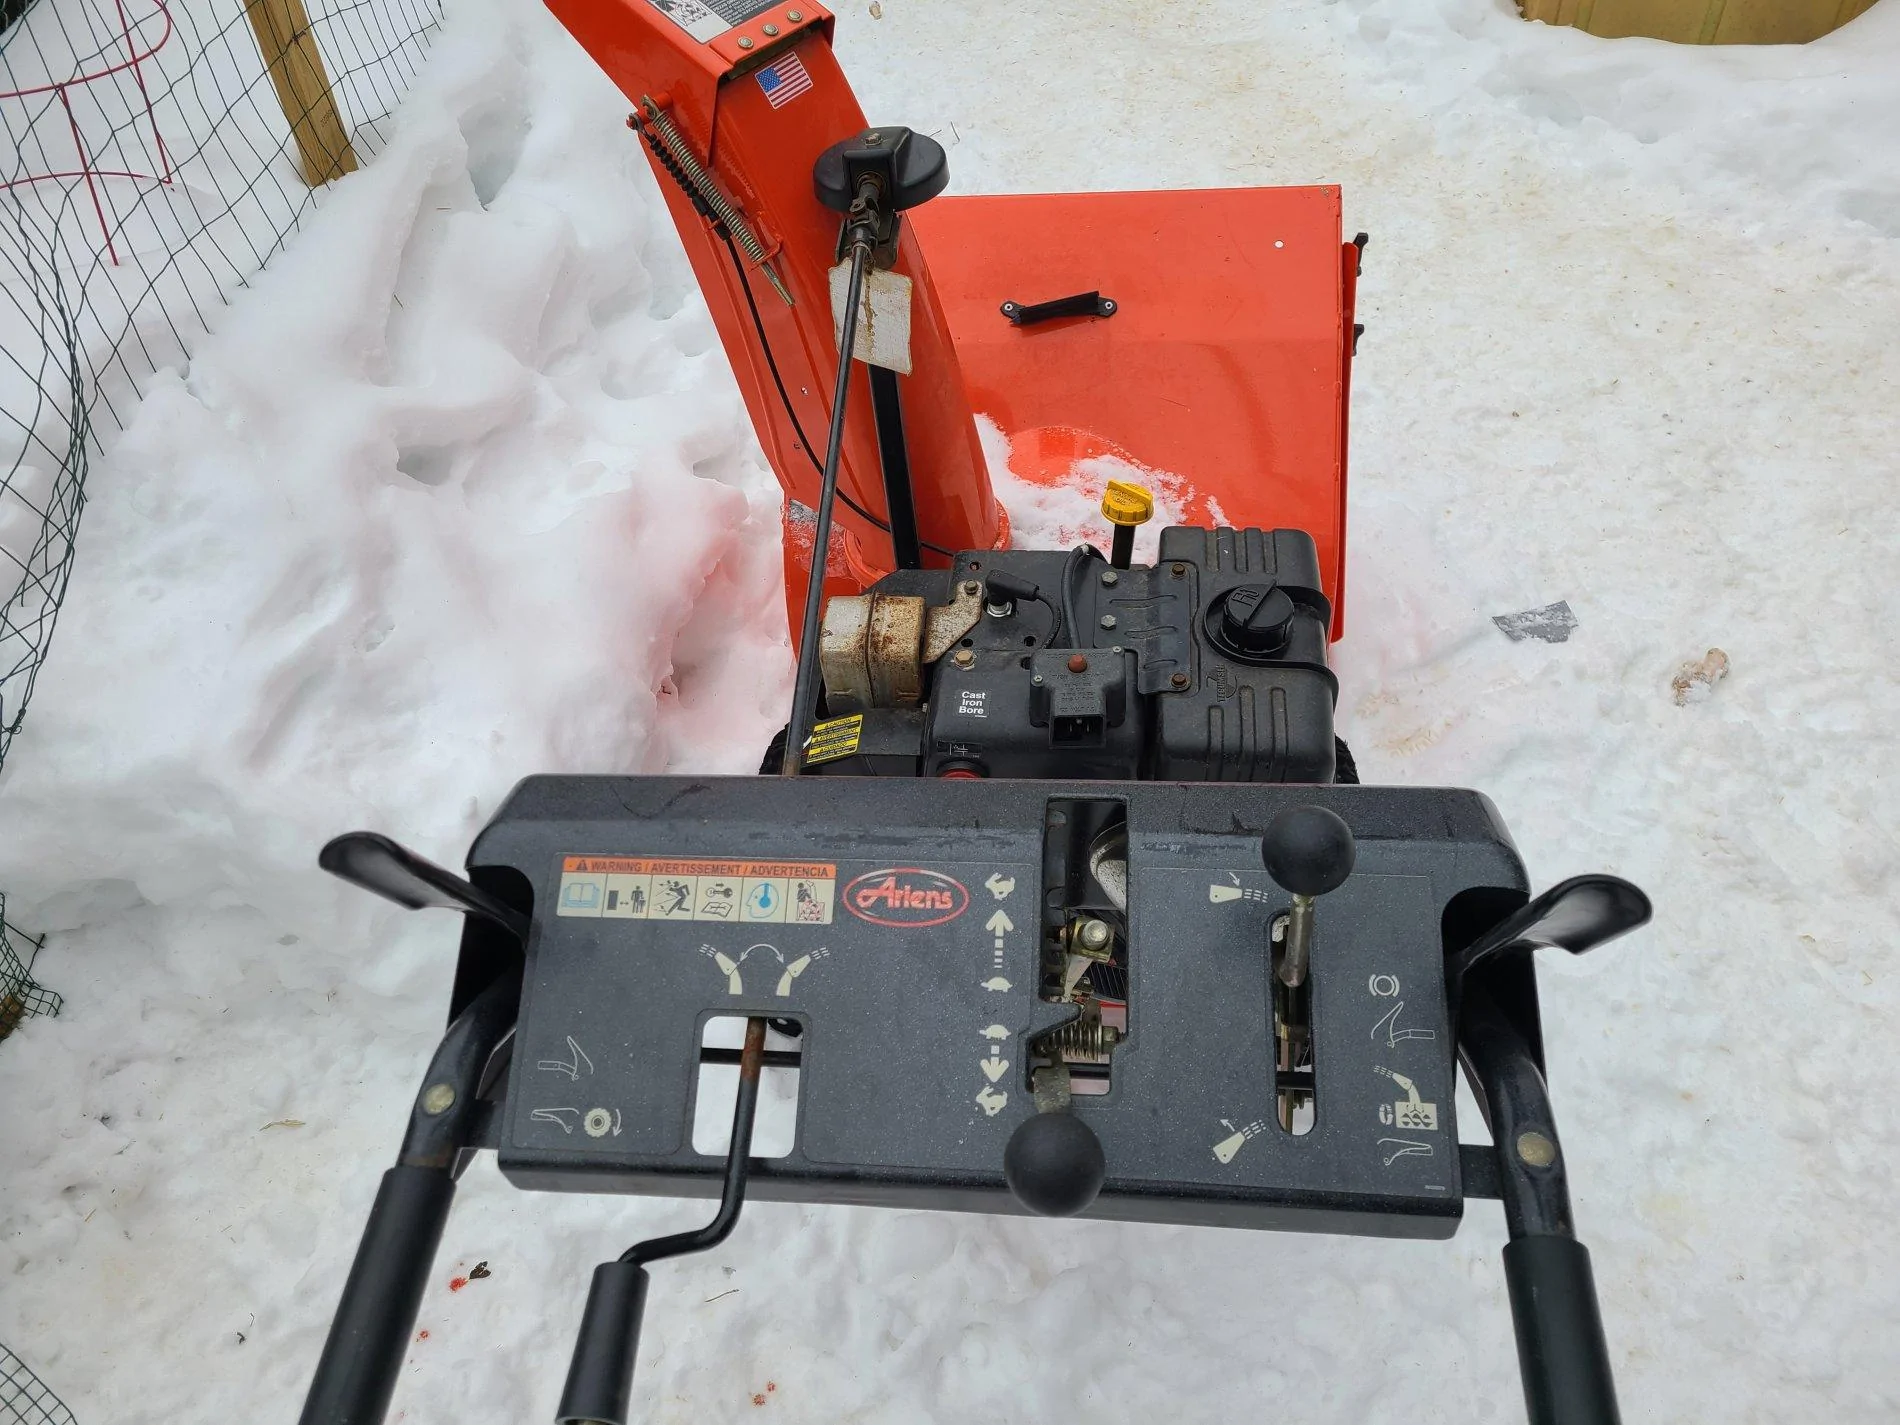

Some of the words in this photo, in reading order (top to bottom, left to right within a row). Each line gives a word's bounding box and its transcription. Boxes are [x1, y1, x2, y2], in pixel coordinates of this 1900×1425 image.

[961, 691, 986, 699] Cast
[958, 706, 984, 714] Bore
[591, 860, 642, 873] WARNING
[651, 861, 741, 875] AVERTISSEMENT
[751, 864, 829, 877] ADVERTENCIA
[855, 876, 954, 909] Ariens
